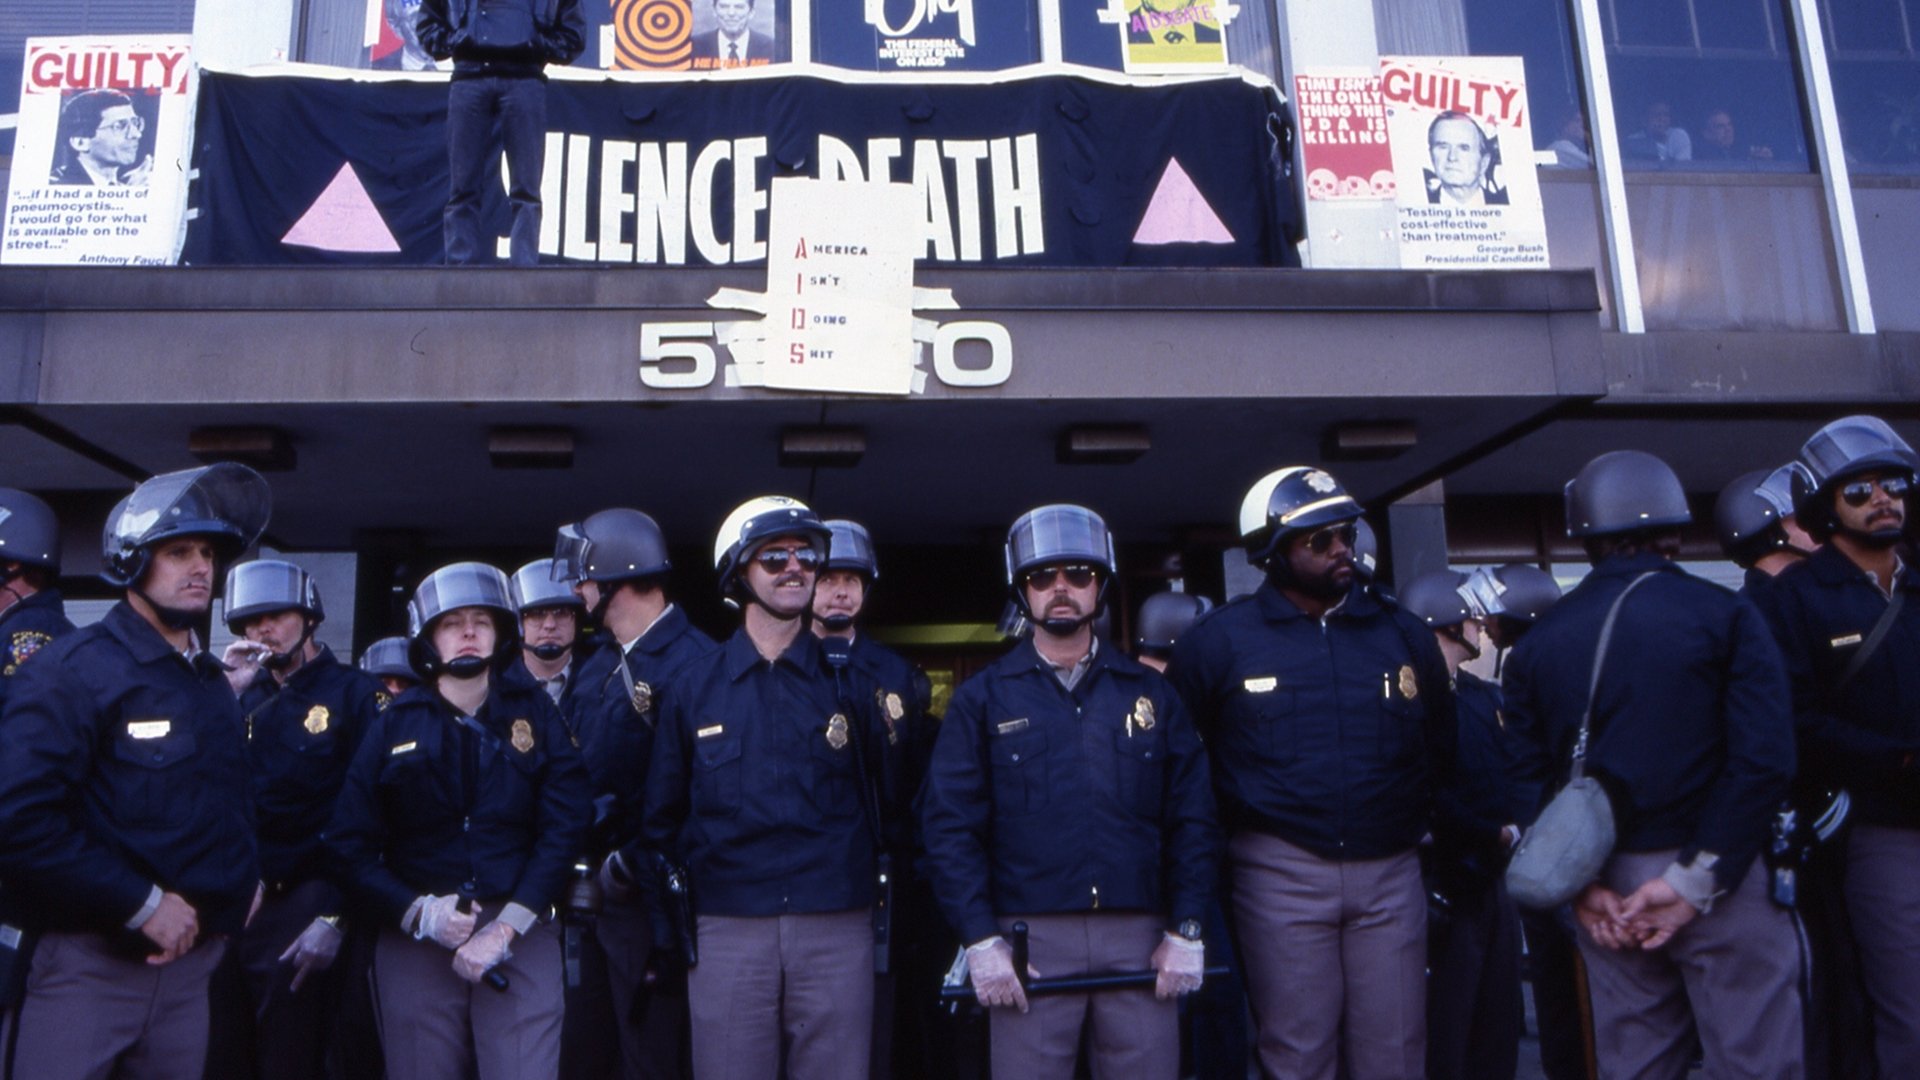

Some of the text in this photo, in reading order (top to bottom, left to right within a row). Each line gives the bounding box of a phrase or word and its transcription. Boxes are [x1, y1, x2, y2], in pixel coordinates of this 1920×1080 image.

[884, 39, 959, 49] THE FEDERAL
[879, 48, 965, 58] INTEREST RATE
[896, 58, 946, 67] ON AIDS
[31, 51, 185, 90] GUILTY
[1297, 77, 1336, 91] TIME
[1299, 91, 1382, 104] THE ONLY
[1383, 69, 1519, 120] GUILTY
[1301, 104, 1385, 118] THING THE
[1366, 117, 1386, 131] IS
[1304, 130, 1388, 144] KILLING
[53, 189, 81, 198] had
[97, 189, 130, 198] bout
[135, 189, 149, 198] of
[496, 132, 767, 265] ILENCE
[11, 201, 124, 213] pneumocystis...
[1456, 208, 1467, 217] is
[19, 213, 61, 225] would
[65, 216, 83, 225] go
[87, 213, 107, 223] for
[111, 213, 148, 223] what
[1400, 220, 1488, 229] cost-effective
[8, 228, 20, 236] is
[24, 226, 88, 236] available
[115, 226, 139, 236] the
[1477, 244, 1544, 253] George Bush
[79, 254, 129, 266] Anthony
[1425, 255, 1545, 263] Presidential Candidate
